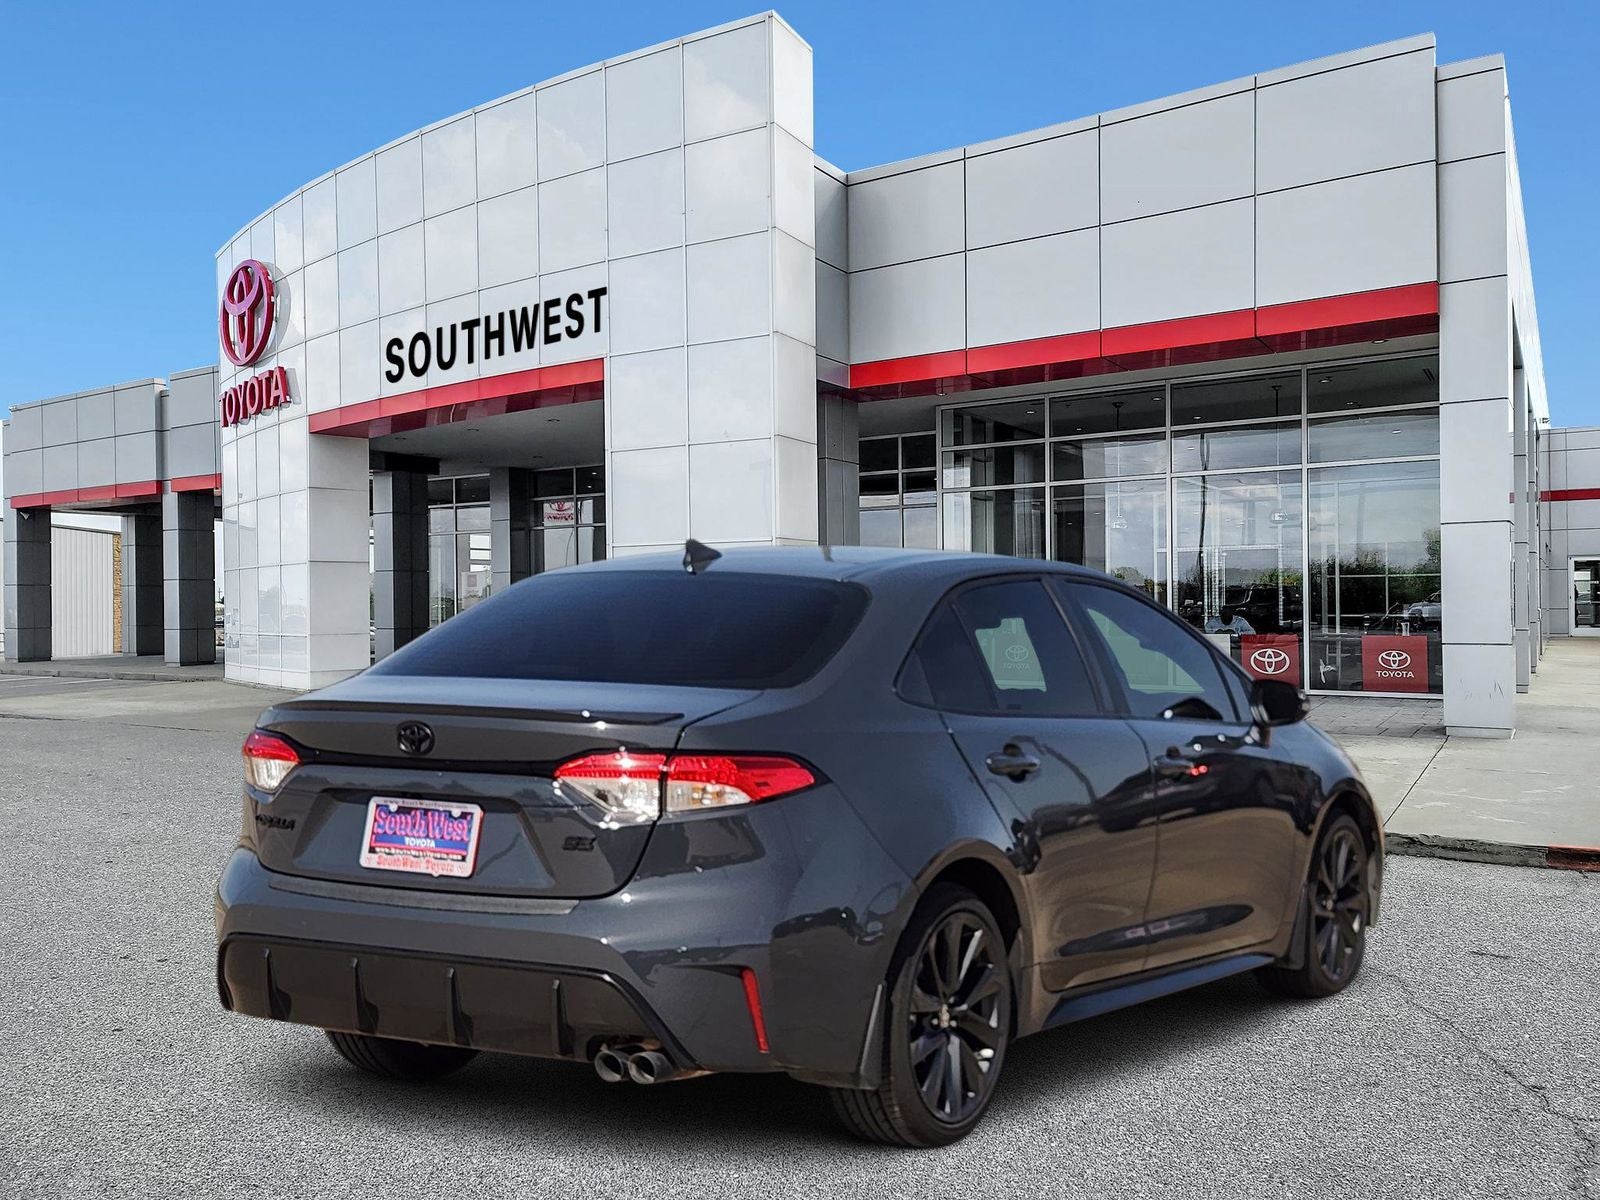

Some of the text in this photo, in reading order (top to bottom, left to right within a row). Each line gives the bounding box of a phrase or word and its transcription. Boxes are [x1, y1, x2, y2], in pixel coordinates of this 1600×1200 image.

[385, 286, 607, 383] SOUTHWEST
[219, 366, 289, 427] TOYOTA
[1376, 670, 1415, 678] TOYOTA
[405, 837, 435, 848] TOYOTA
